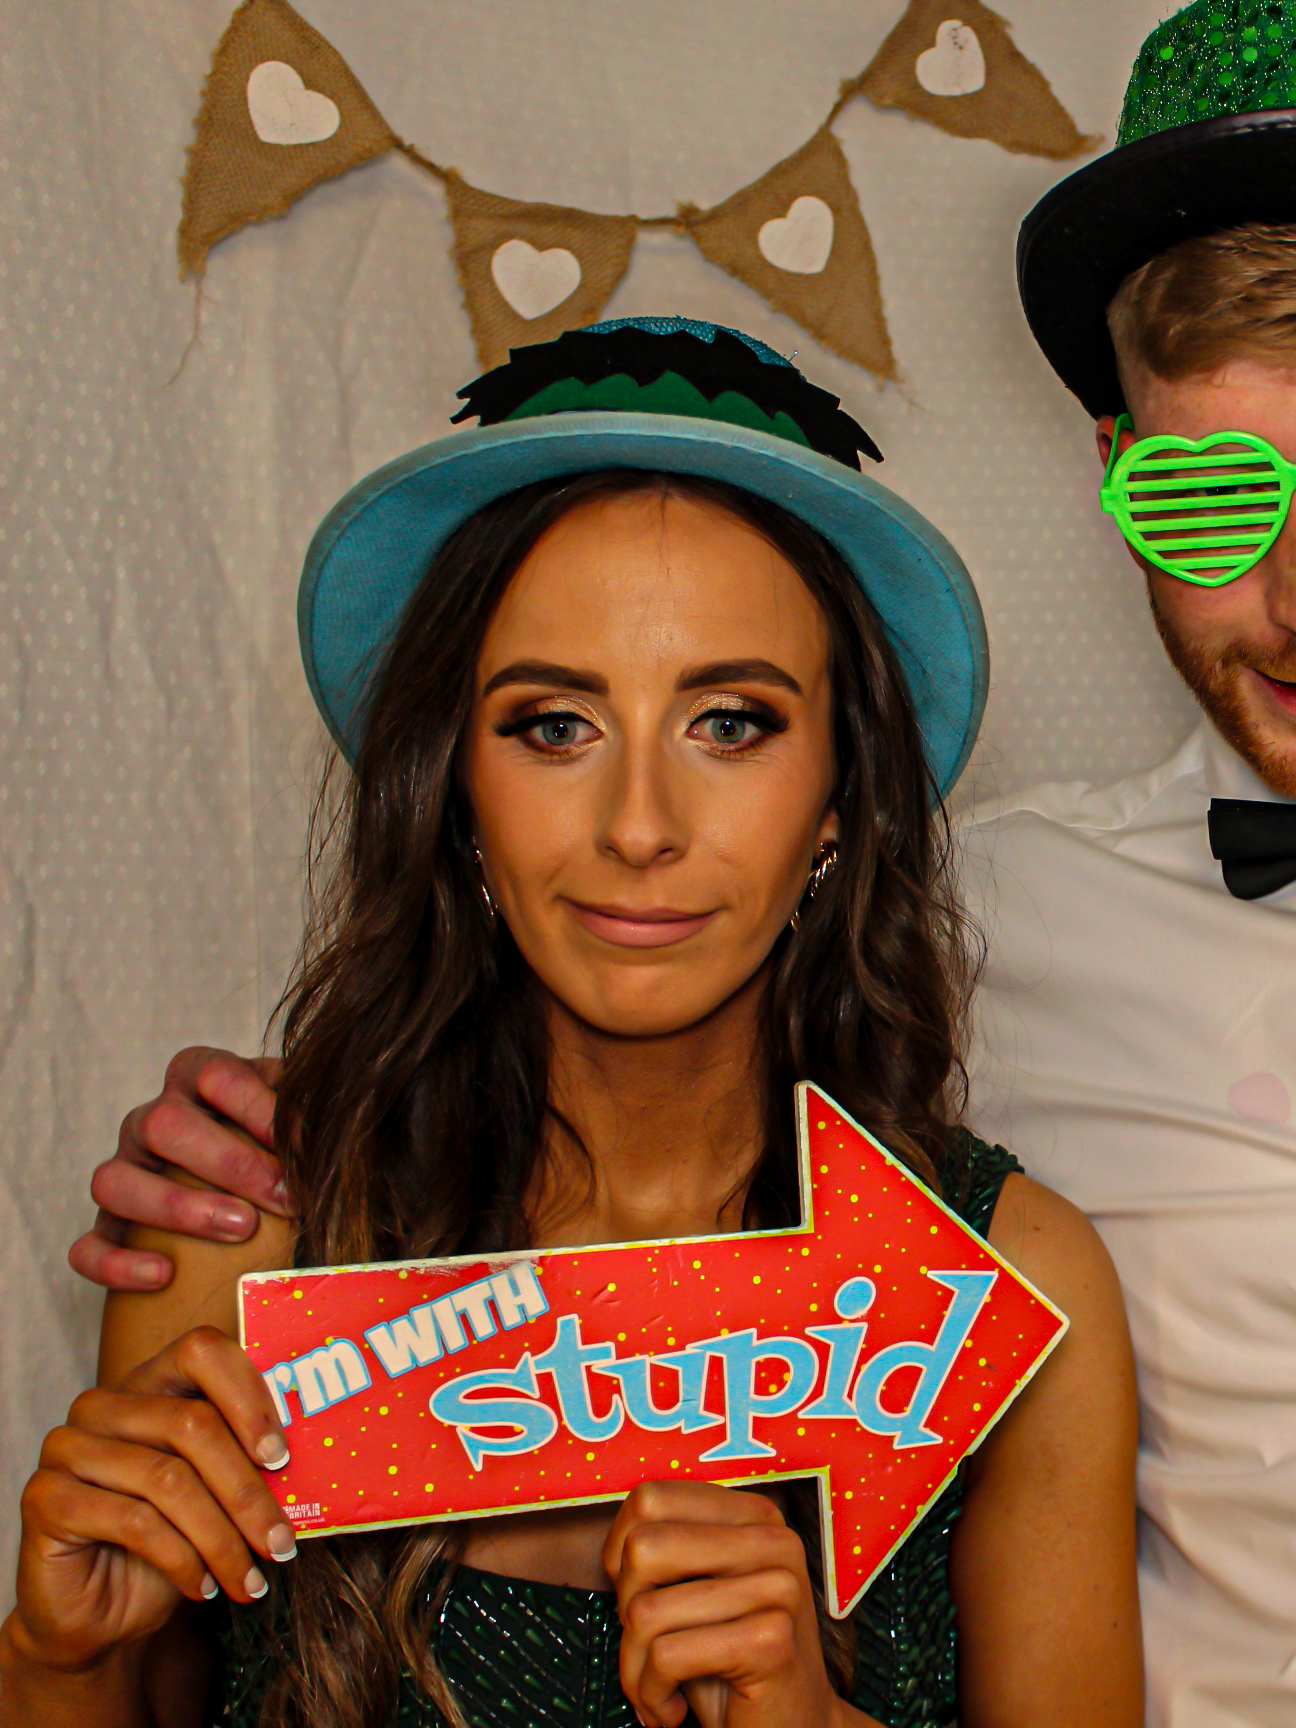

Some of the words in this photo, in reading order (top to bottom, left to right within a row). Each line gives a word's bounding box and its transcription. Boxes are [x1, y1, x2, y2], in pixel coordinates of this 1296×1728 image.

[364, 1261, 550, 1378] WITH
[429, 1270, 999, 1471] stupid
[289, 1503, 311, 1513] MADE
[312, 1502, 321, 1511] IN
[289, 1509, 321, 1519] BRITAIN
